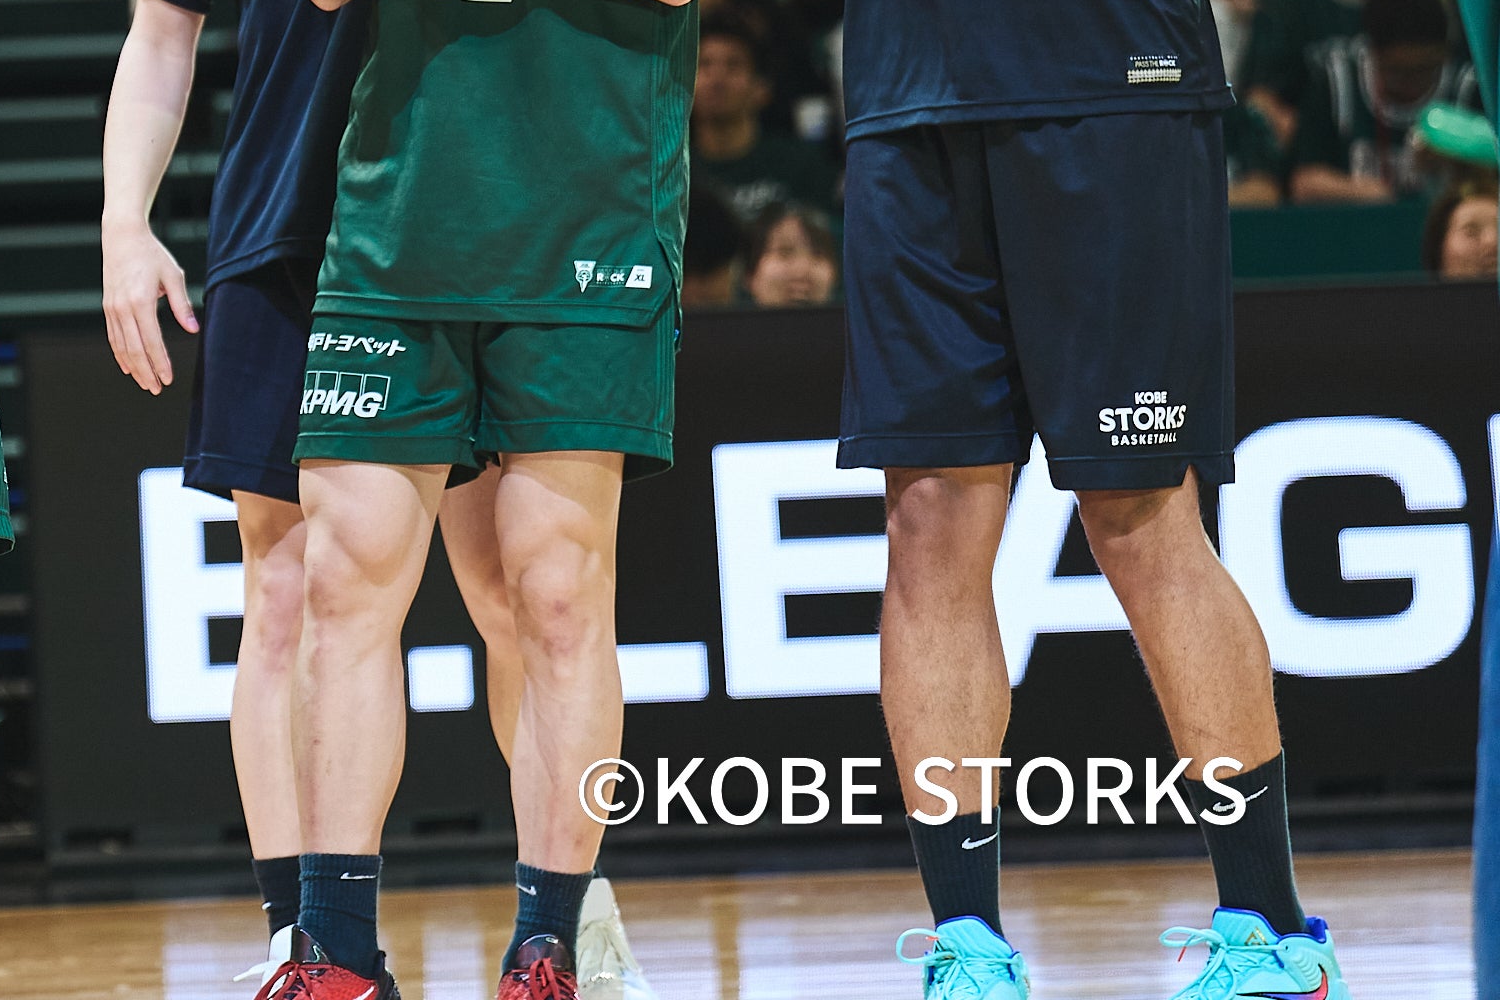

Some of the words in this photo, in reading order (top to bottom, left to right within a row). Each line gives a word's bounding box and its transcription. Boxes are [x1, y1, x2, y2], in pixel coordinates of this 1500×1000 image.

[300, 389, 384, 418] KPMG
[1135, 391, 1168, 405] KOBE
[1099, 404, 1187, 433] STORKS
[1111, 432, 1177, 446] BASKETBALL
